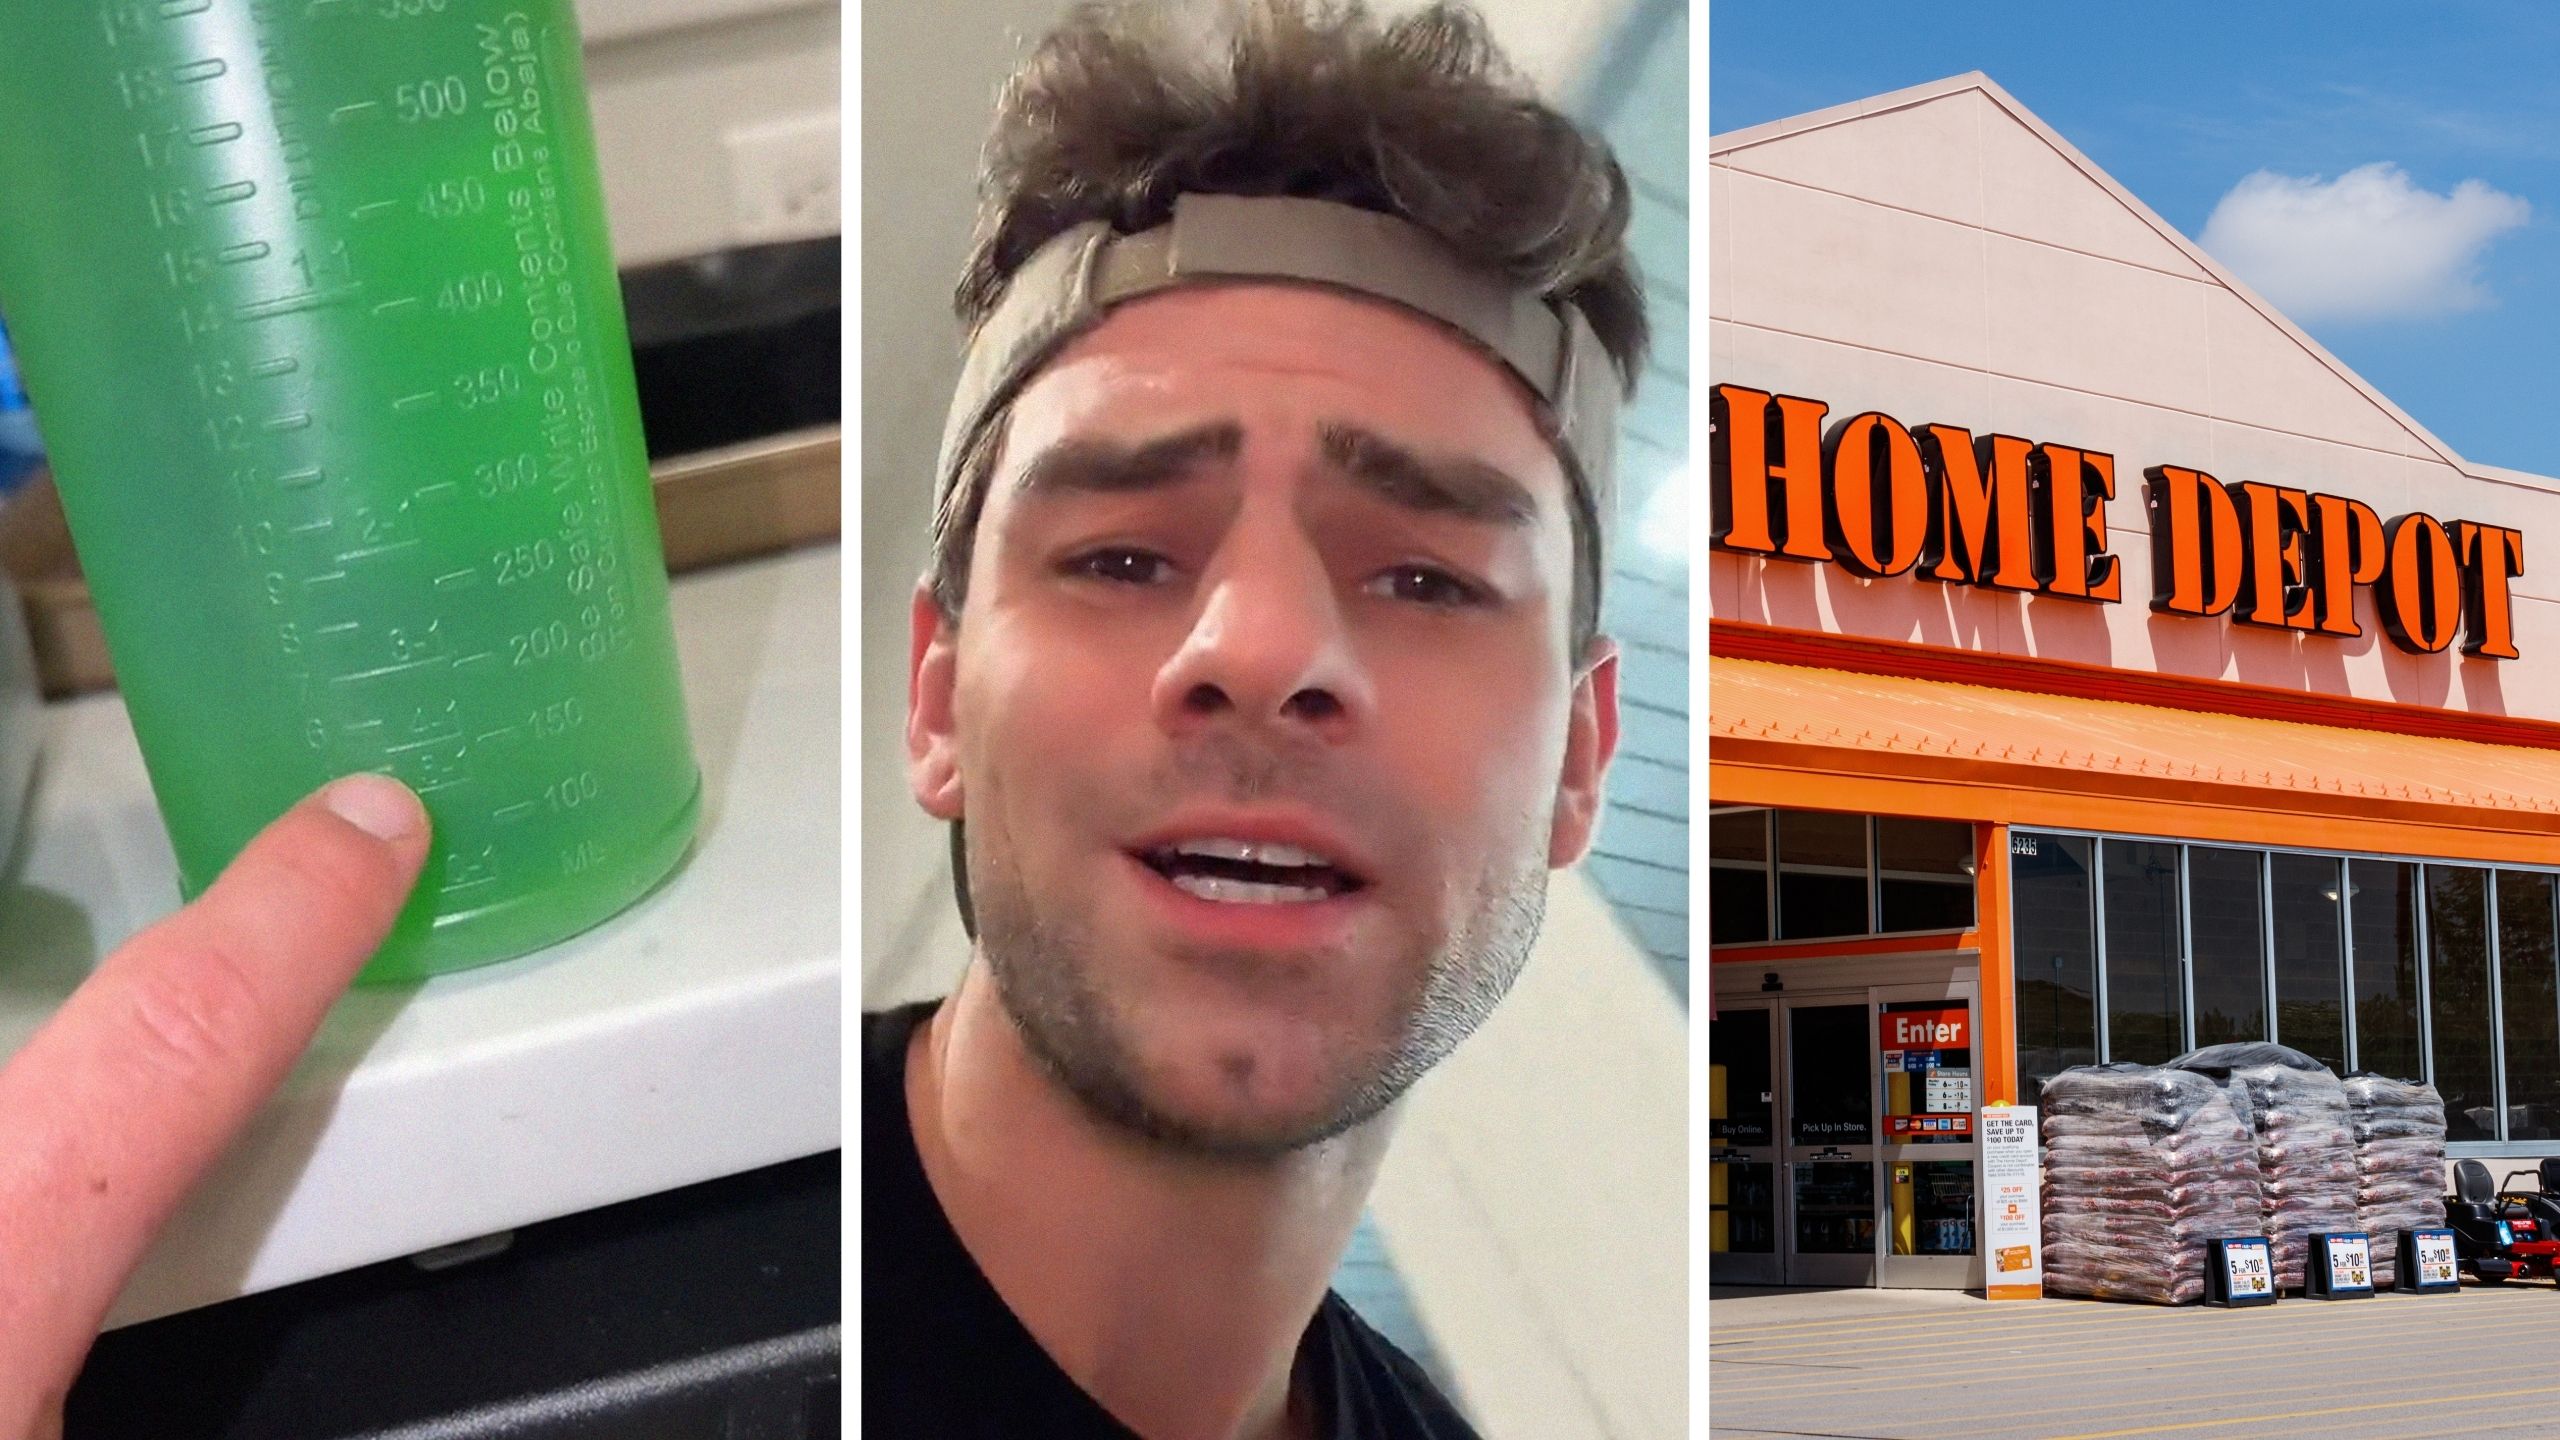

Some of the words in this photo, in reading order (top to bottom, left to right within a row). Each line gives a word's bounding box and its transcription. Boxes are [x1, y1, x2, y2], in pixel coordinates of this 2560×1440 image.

[396, 75, 467, 125] 500
[475, 22, 524, 172] Below
[417, 176, 485, 219] 450
[437, 270, 503, 316] 400
[506, 187, 557, 374] Contents
[454, 364, 519, 410] 350
[542, 386, 576, 494] Write
[474, 453, 538, 498] 300
[1710, 383, 2122, 604] HOME
[2143, 464, 2524, 660] DEPOT
[493, 538, 554, 585] 250
[558, 501, 595, 595] Safe
[510, 620, 568, 667] 200
[579, 603, 605, 662] Be
[528, 697, 583, 739] 150
[544, 771, 598, 814] 100
[2012, 837, 2037, 855] 6235
[1896, 1017, 1962, 1044] Enter
[1722, 1125, 1736, 1135] Buy
[1738, 1124, 1764, 1134] Online.
[1802, 1123, 1819, 1132] Pick
[1821, 1123, 1832, 1133] Up
[1834, 1122, 1841, 1131] In
[1843, 1122, 1867, 1132] Store.
[2014, 1119, 2034, 1127] CARD,
[2230, 1260, 2237, 1274] 5
[2245, 1259, 2259, 1273] $10
[2332, 1254, 2339, 1268] 5
[2346, 1253, 2359, 1267] $10
[2420, 1250, 2427, 1264] 5
[2433, 1249, 2445, 1262] $10
